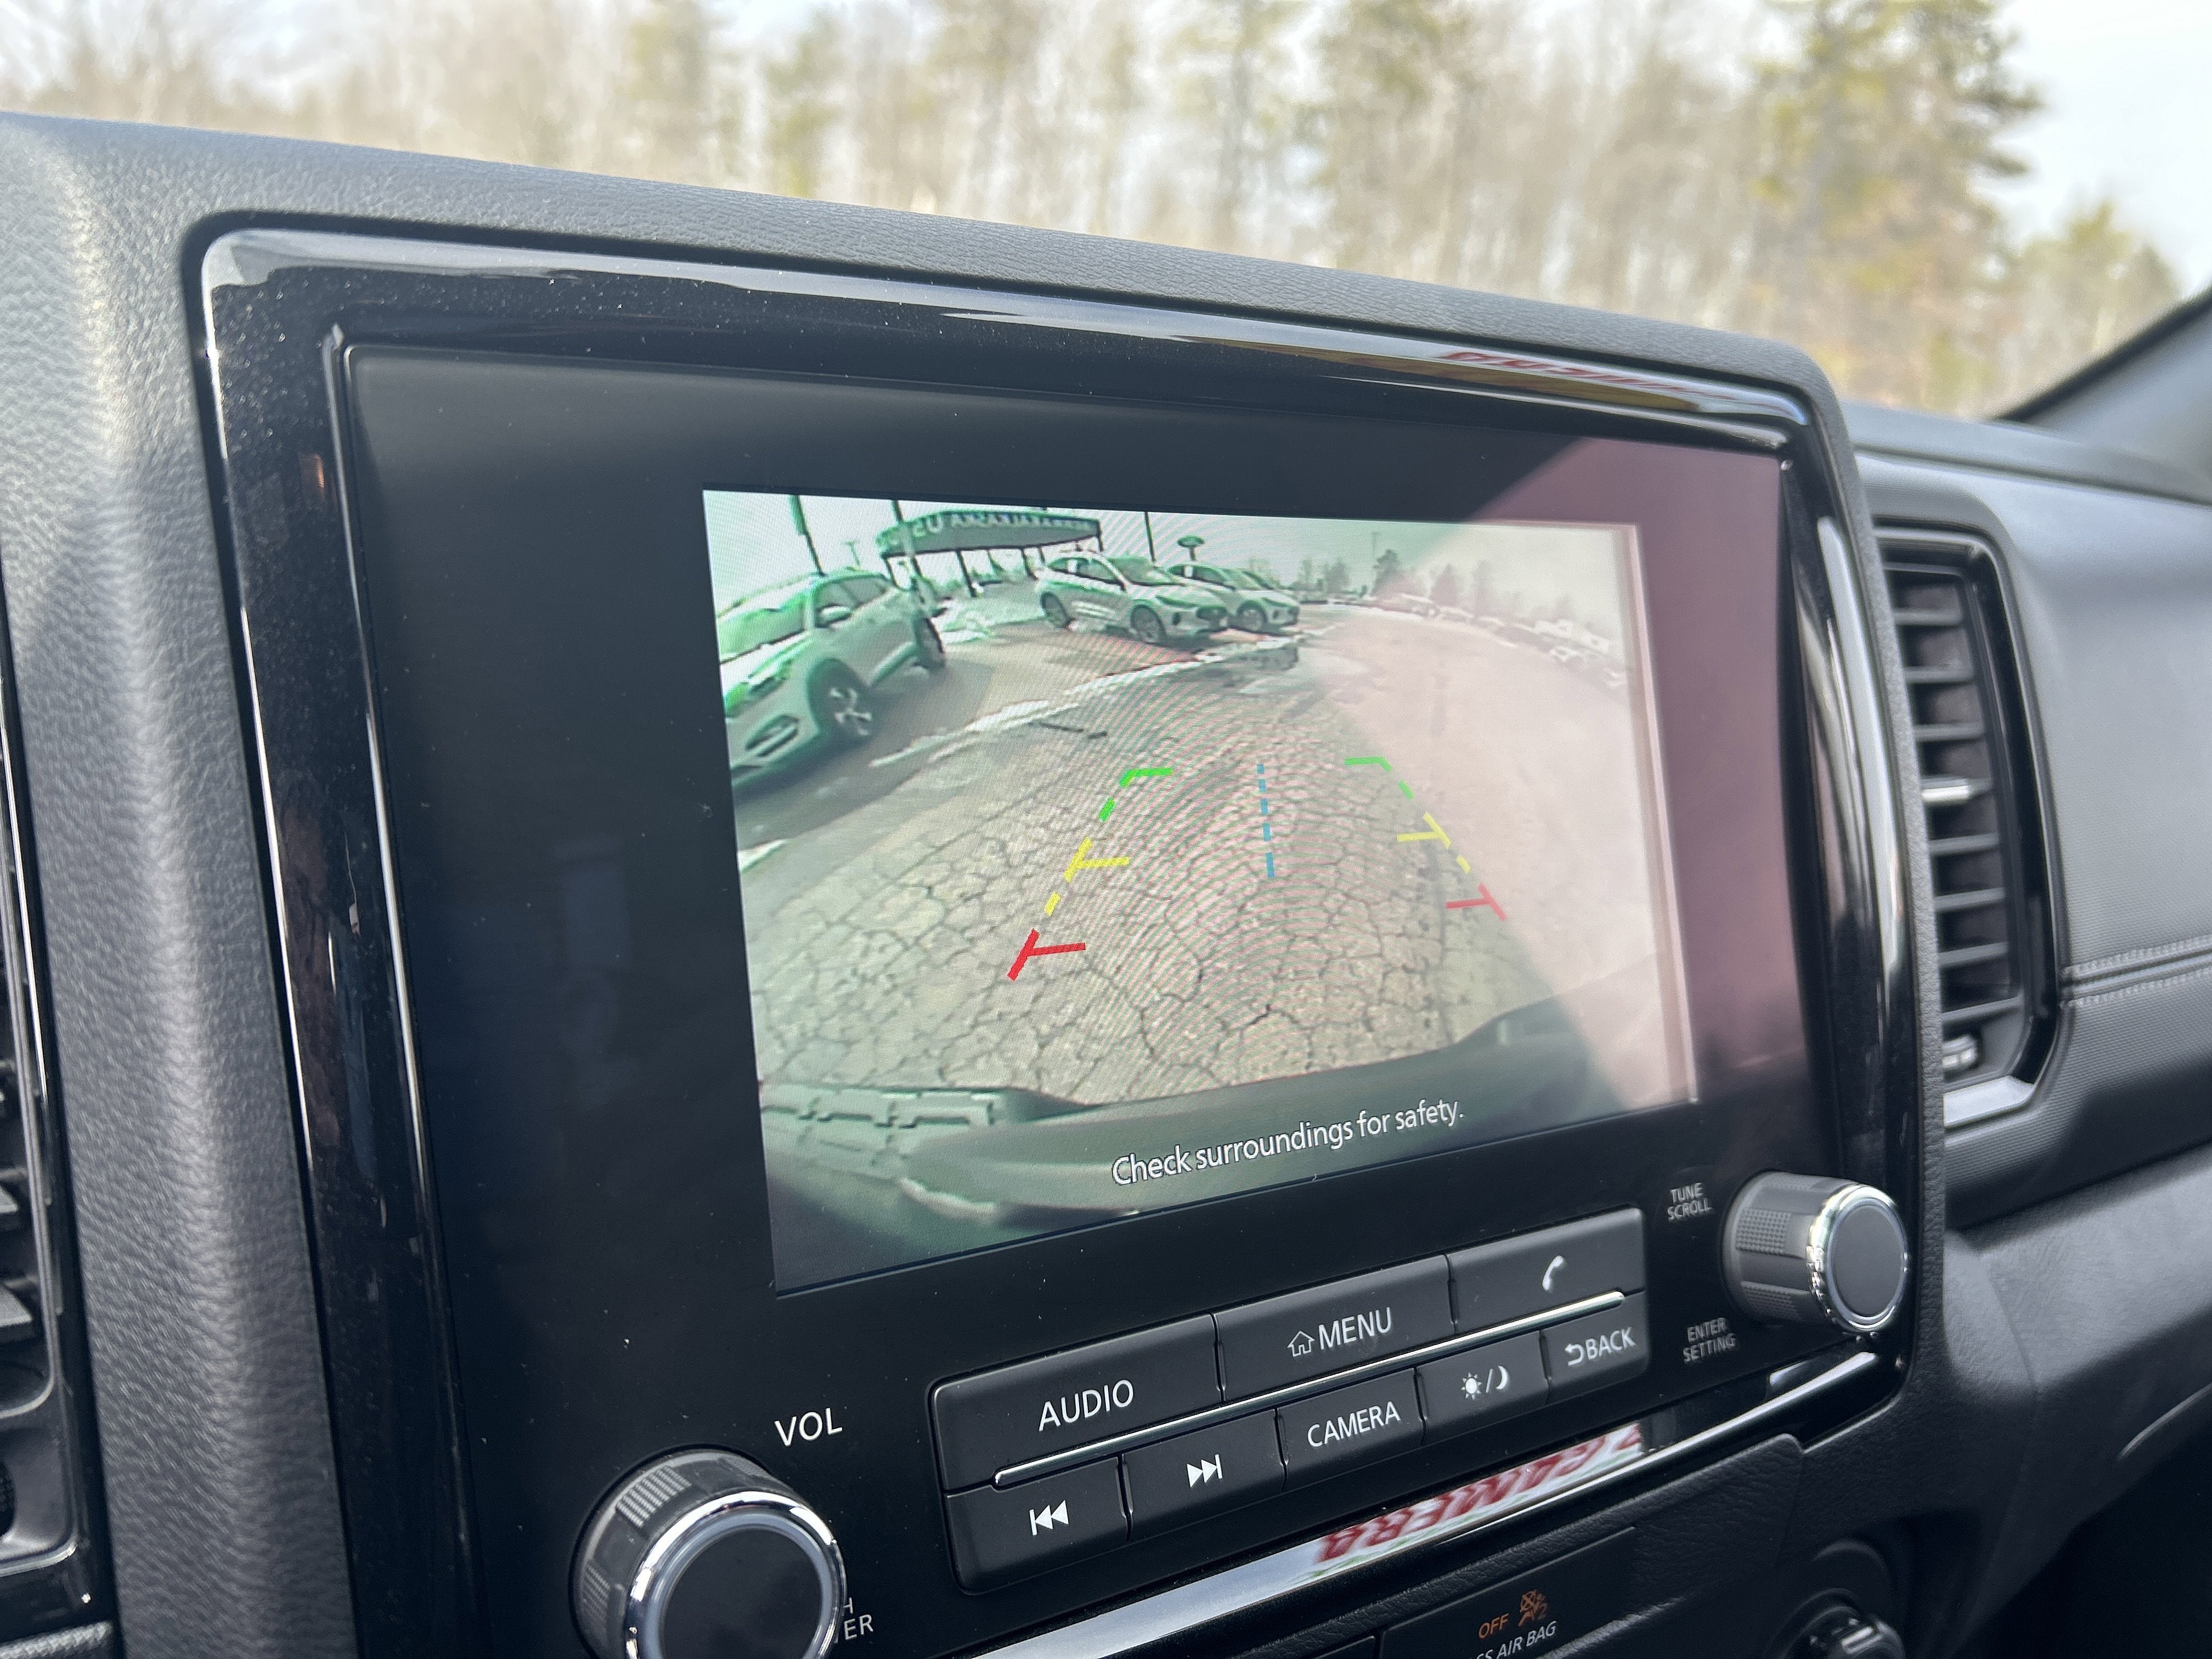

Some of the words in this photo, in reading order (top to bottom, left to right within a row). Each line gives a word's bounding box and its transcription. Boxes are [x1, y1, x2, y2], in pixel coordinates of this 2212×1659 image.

[1111, 1145, 1192, 1186] Check
[1195, 1119, 1353, 1170] surroundings
[1356, 1109, 1390, 1137] for
[1395, 1098, 1464, 1128] safety.
[1667, 1198, 1712, 1221] SCROLL
[1671, 1182, 1703, 1204] TUNE
[1319, 1307, 1392, 1350] MENU
[1585, 1327, 1635, 1360] BACK
[1688, 1318, 1726, 1342] ENTER
[1683, 1333, 1736, 1363] SETTING
[1039, 1380, 1134, 1431] AUDIO
[775, 1407, 843, 1446] VOL
[1307, 1401, 1401, 1448] CAMERA
[1479, 1613, 1509, 1639] OFF
[1496, 1636, 1523, 1659] AIR
[1526, 1621, 1557, 1646] BAG
